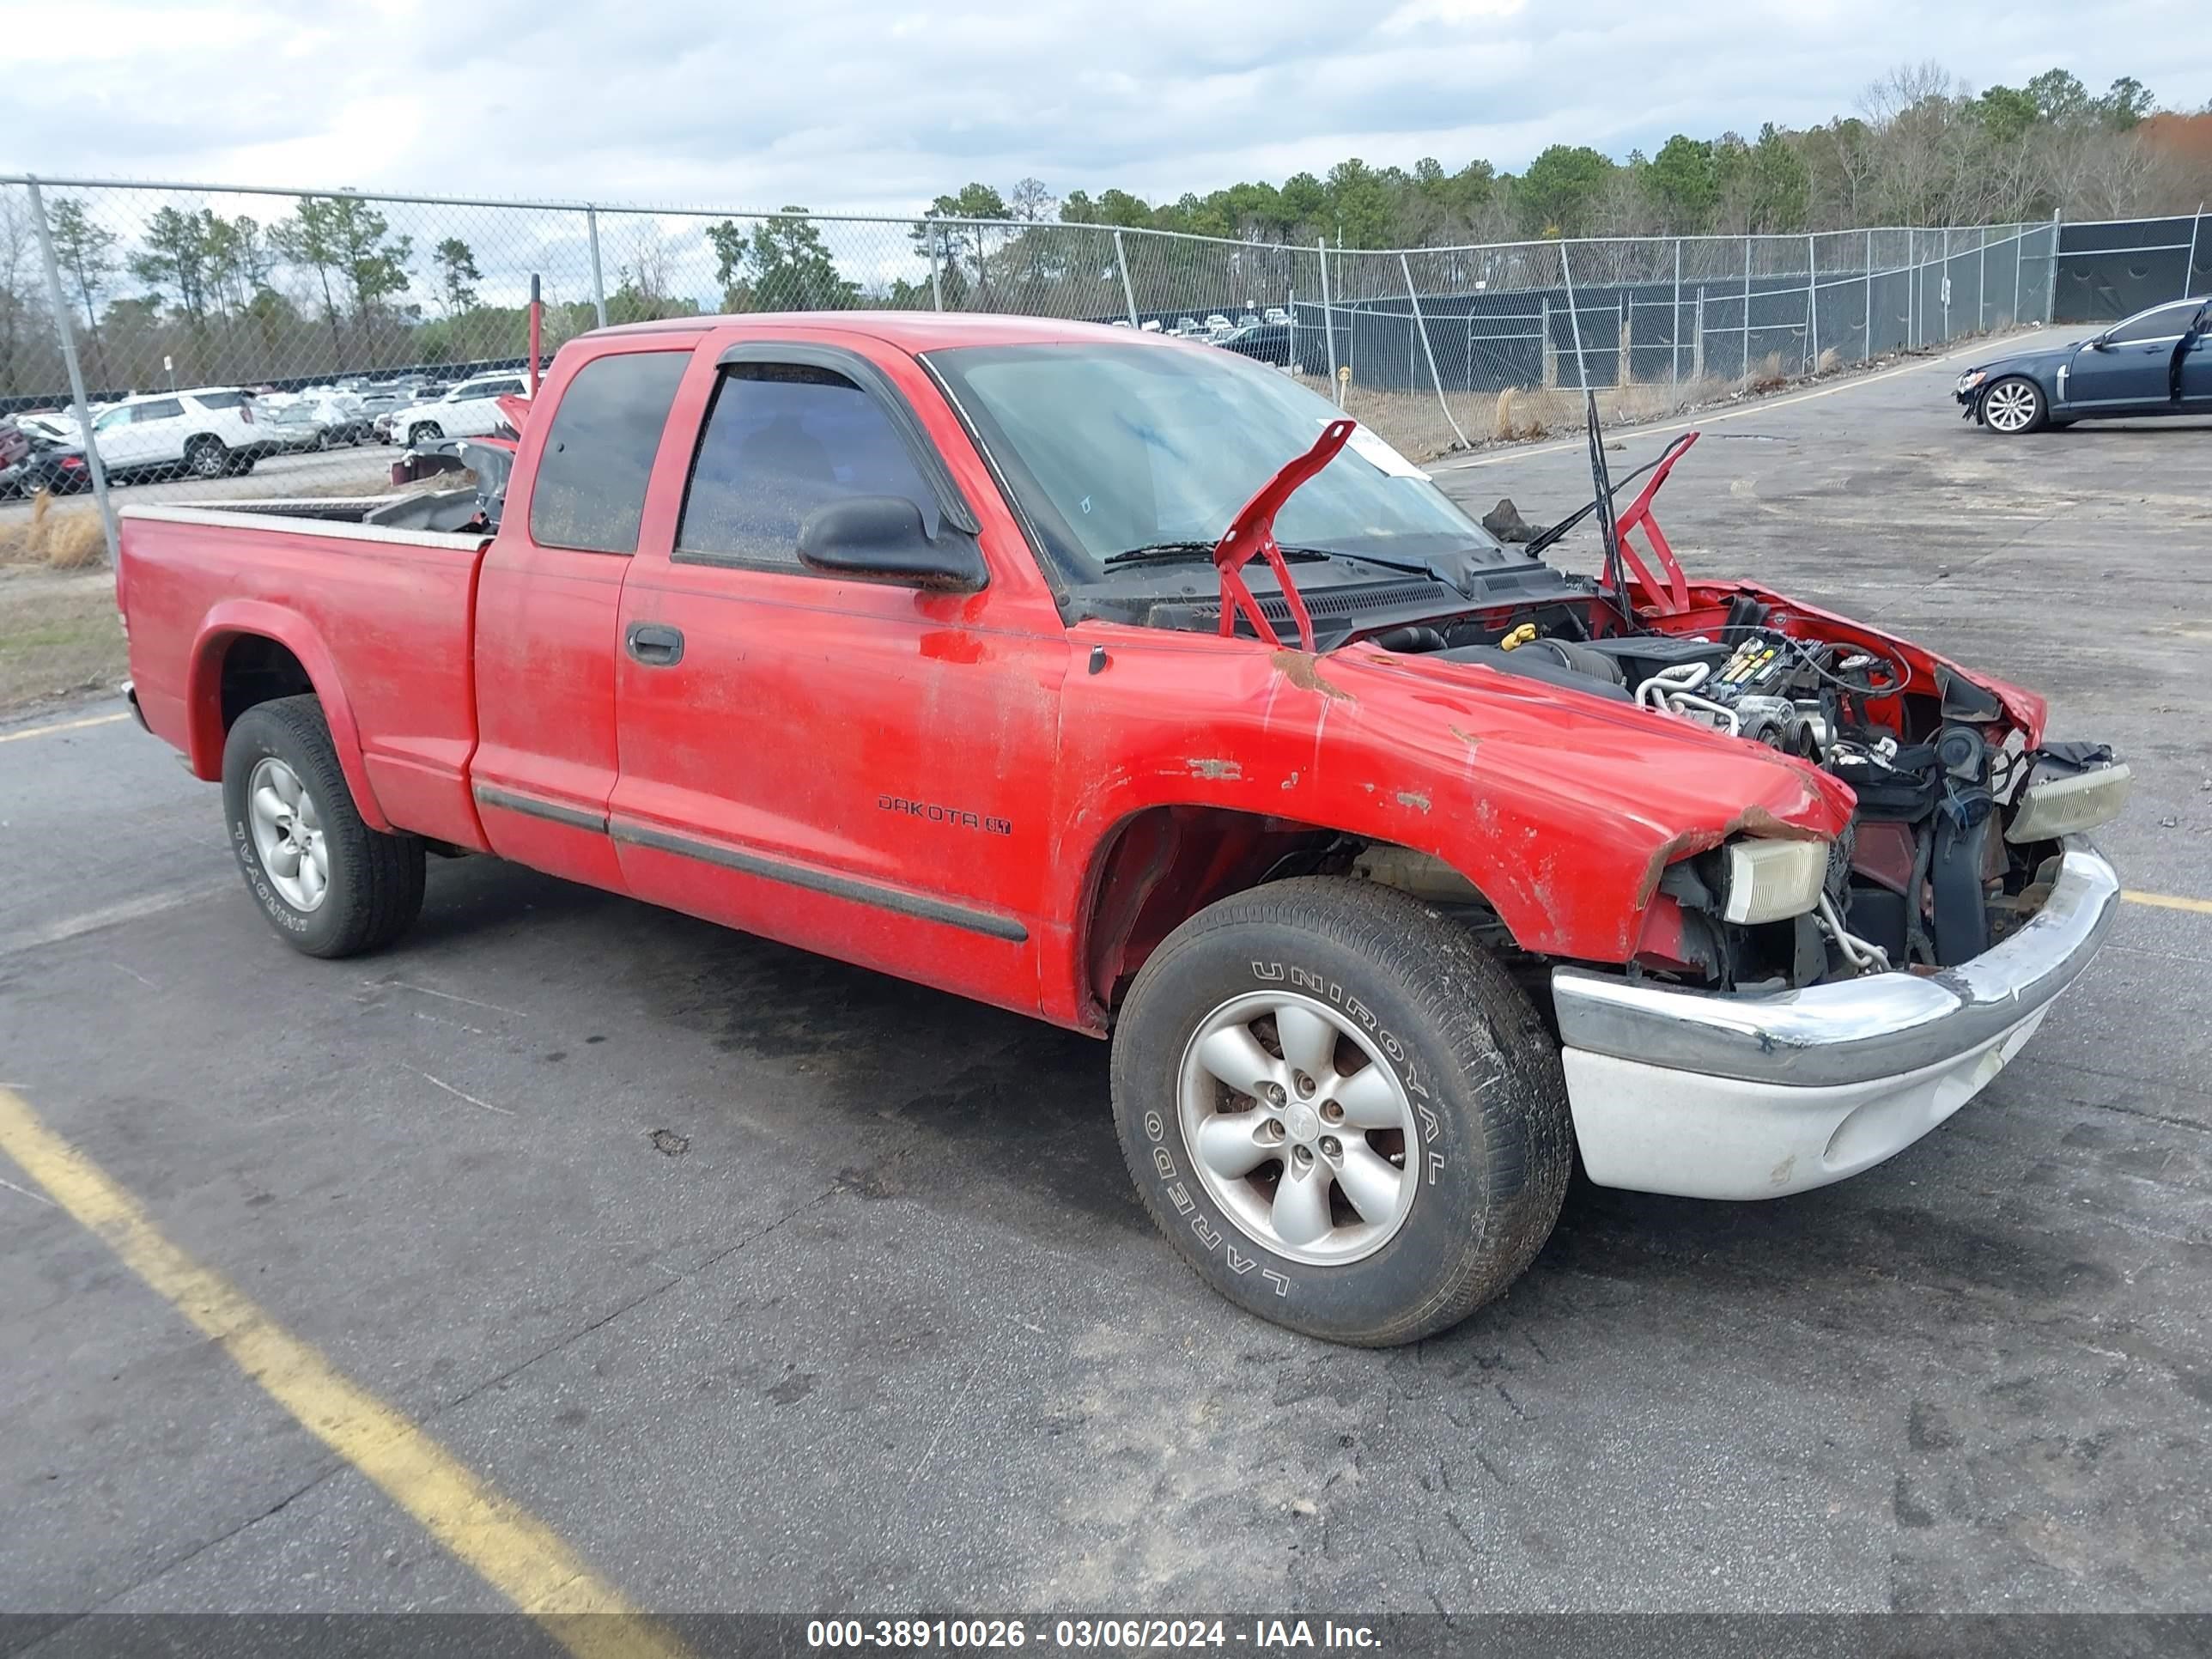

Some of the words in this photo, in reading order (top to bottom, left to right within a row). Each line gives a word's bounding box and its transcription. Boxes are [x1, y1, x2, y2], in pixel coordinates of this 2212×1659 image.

[878, 794, 978, 829] DAKOTA
[985, 817, 1012, 836] SLT
[1251, 960, 1445, 1186] UNIROYAL
[1144, 1110, 1291, 1297] LAREDO
